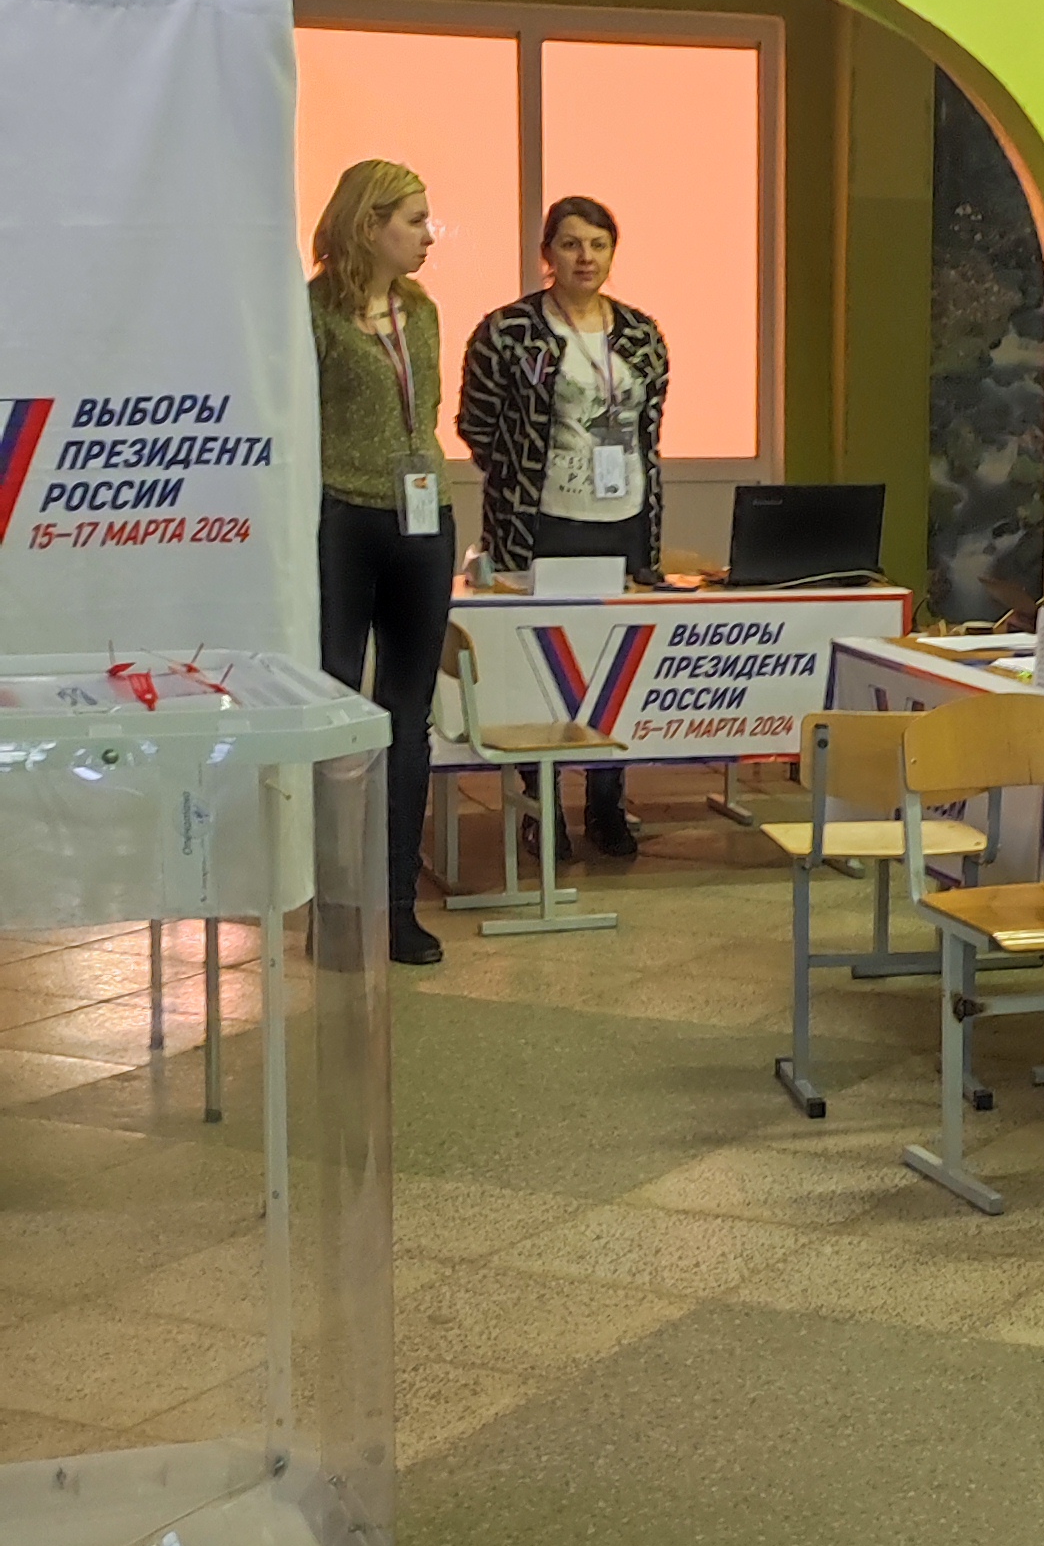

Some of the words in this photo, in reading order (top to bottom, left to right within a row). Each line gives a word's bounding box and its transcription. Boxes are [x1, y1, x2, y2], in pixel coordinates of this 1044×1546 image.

[71, 394, 231, 428] ВЫБОРЫ
[55, 436, 273, 470] ПРЕЗИДЕНТА
[39, 478, 185, 513] РОССИИ
[100, 517, 187, 547] МАРТА
[189, 517, 251, 543] 2024
[667, 621, 785, 647] ВЫБОРЫ
[654, 653, 817, 681] ПРЕЗИДЕНТА
[641, 686, 748, 713] РОССИИ
[684, 716, 748, 739] МАРТА
[749, 715, 794, 736] 2024
